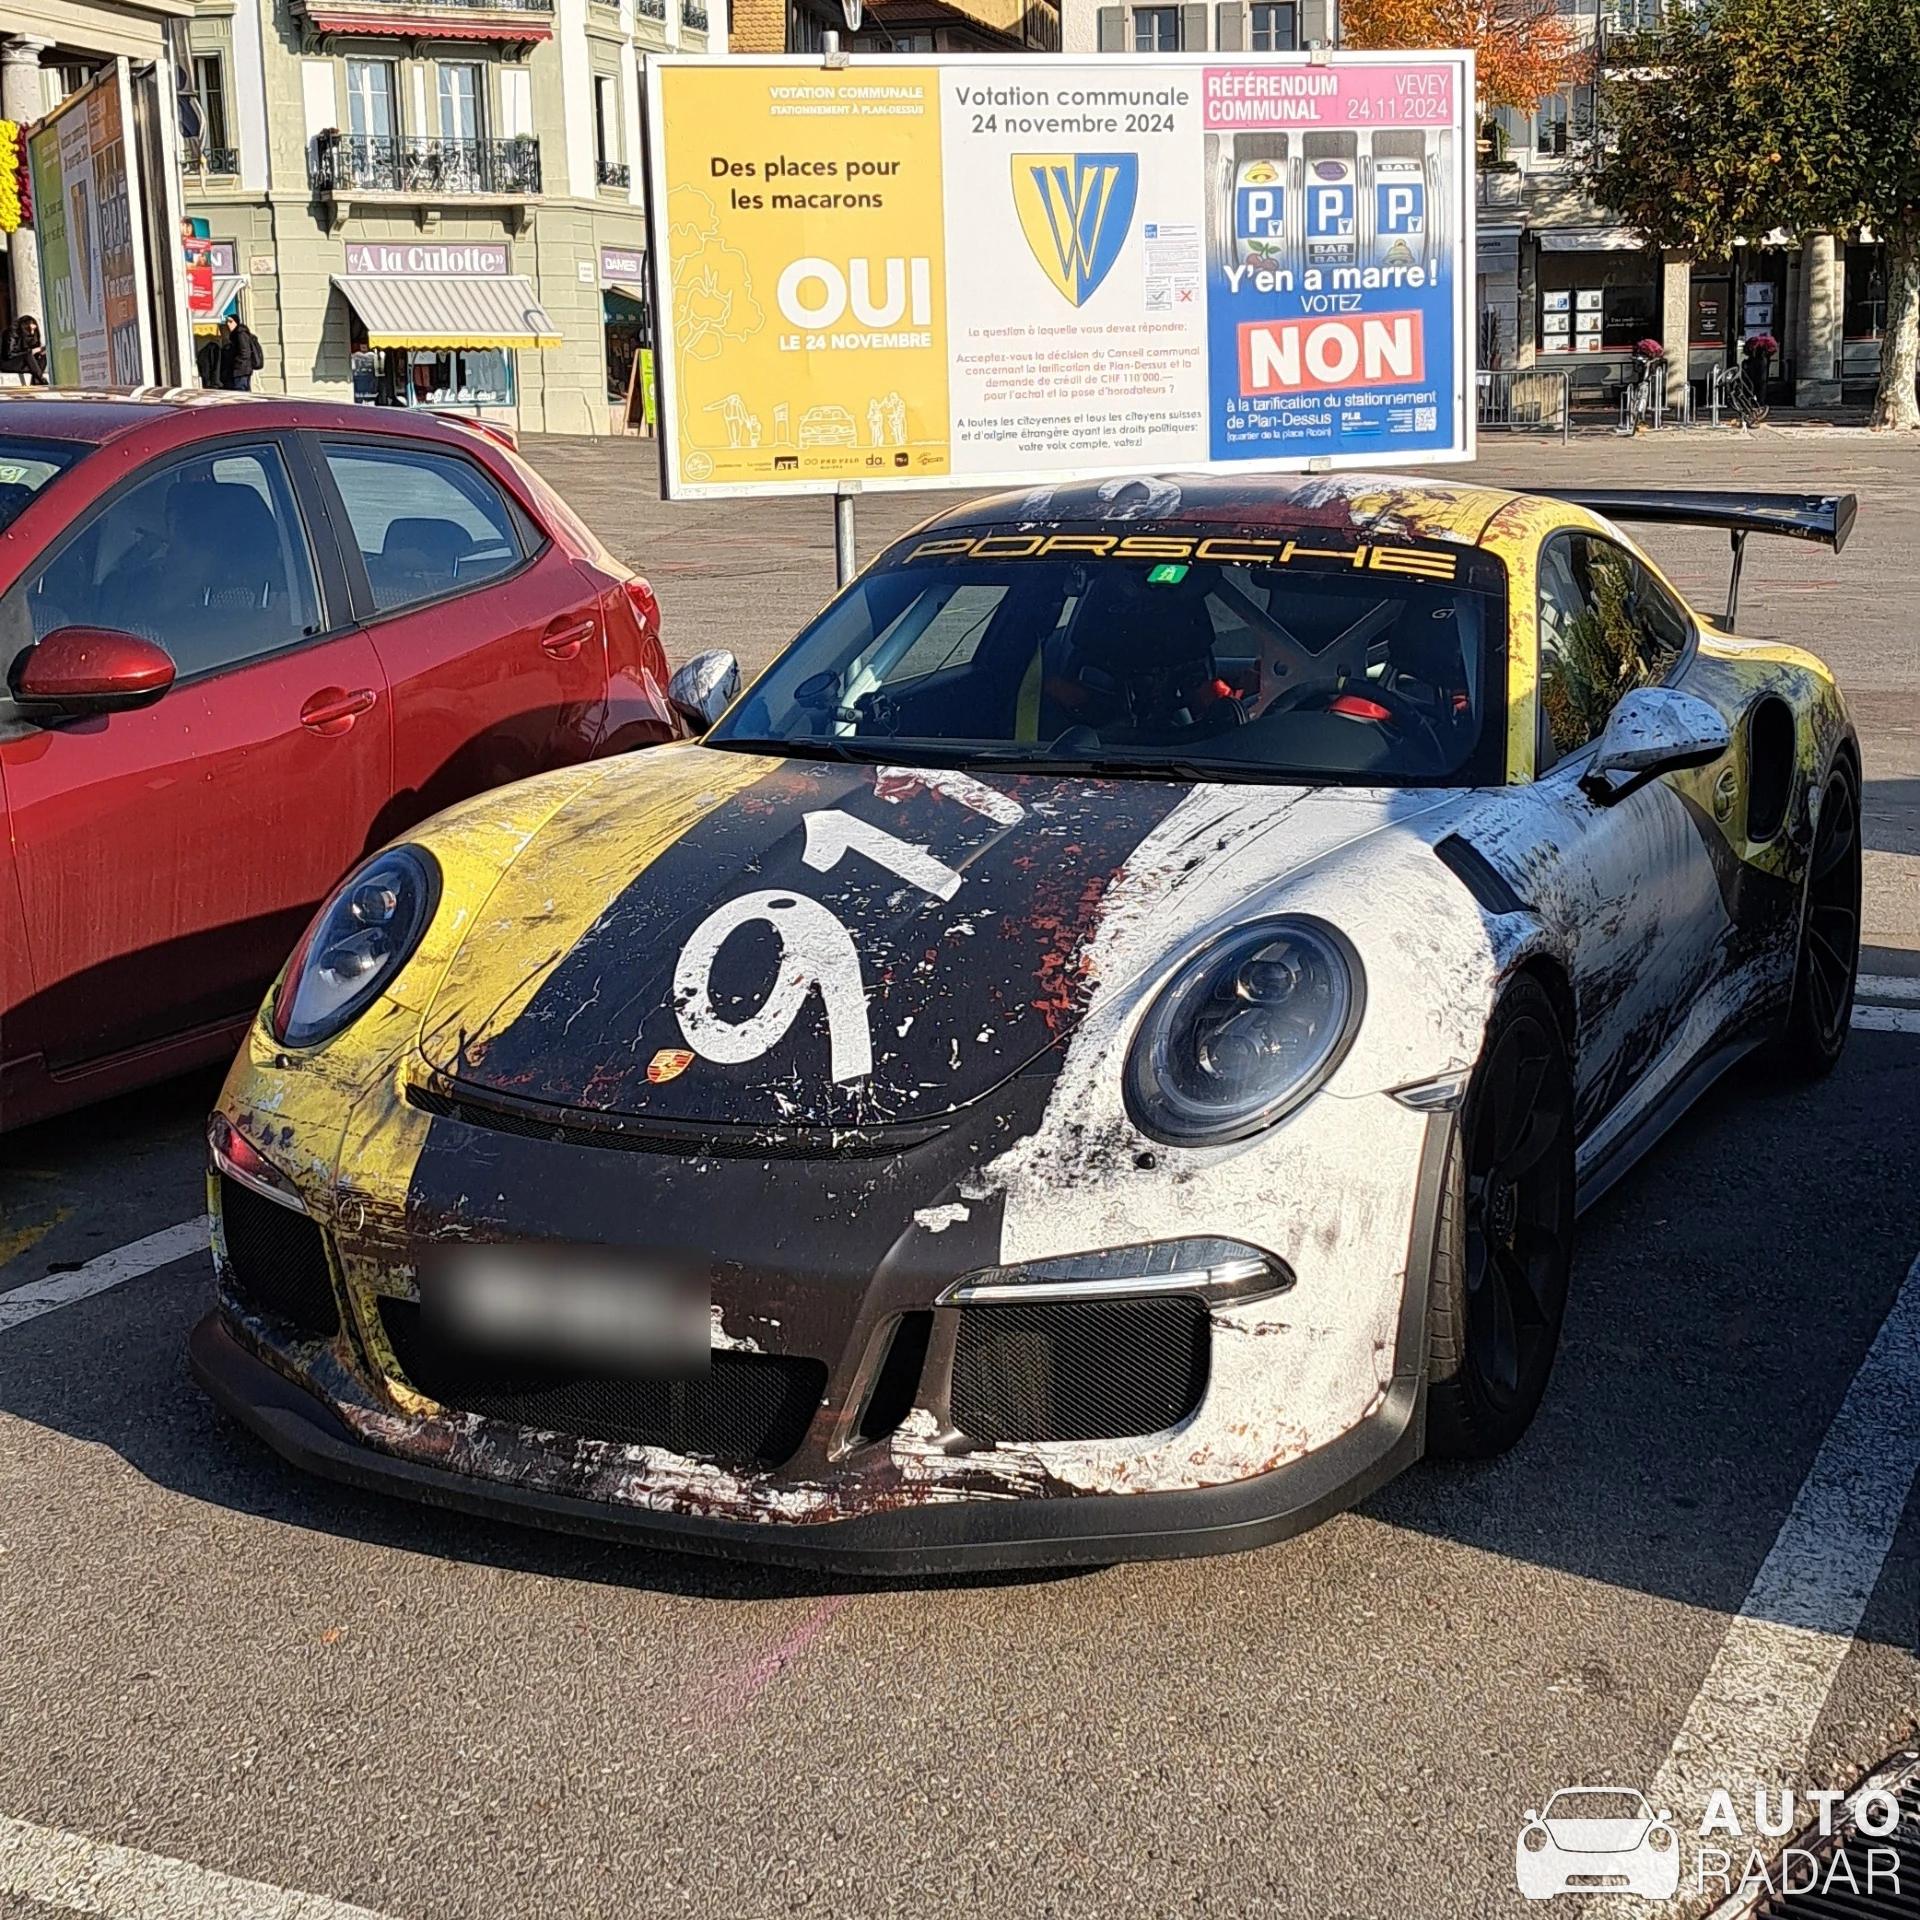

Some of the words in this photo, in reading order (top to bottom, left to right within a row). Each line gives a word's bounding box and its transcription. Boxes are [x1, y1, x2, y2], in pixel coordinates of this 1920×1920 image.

[769, 87, 835, 99] VOTATION
[838, 86, 924, 99] COMMUNALE
[1208, 72, 1337, 97] RÉFÉRENDUM
[1395, 74, 1448, 95] VEVEY
[955, 87, 1049, 106] Votation
[1057, 87, 1189, 106] communale
[770, 105, 850, 116] STATIONNEMENT
[851, 102, 860, 115] À
[862, 104, 924, 115] PLAN-DESSUS
[1208, 100, 1321, 121] COMMUNAL
[1348, 98, 1448, 119] 24.11.2024
[971, 113, 998, 133] 24
[1005, 113, 1118, 133] novembre
[1125, 113, 1175, 133] 2024
[711, 156, 756, 177] Des
[765, 155, 838, 182] places
[846, 160, 901, 182] pour
[1381, 163, 1416, 171] BAR
[731, 188, 764, 210] les
[771, 192, 884, 209] macarons
[1249, 191, 1273, 233] P
[1318, 189, 1343, 231] P
[1388, 188, 1413, 229] P
[1314, 243, 1348, 254] BAR
[380, 247, 403, 272] la
[604, 257, 638, 272] DAMES
[1314, 254, 1348, 264] BAR
[1223, 264, 1294, 293] Y'en
[1304, 269, 1322, 290] a
[777, 257, 932, 329] OUI
[1301, 294, 1362, 312] VOTEZ
[968, 327, 980, 337] La
[983, 327, 1025, 338] question
[1037, 325, 1078, 337] laquelle
[1080, 325, 1103, 334] vous
[1106, 324, 1137, 334] devez
[780, 334, 802, 351] LE
[805, 334, 826, 350] 24
[831, 332, 932, 350] NOVEMBRE
[956, 352, 1033, 364] Acceptez-vous
[1035, 351, 1045, 361] la
[1048, 349, 1089, 360] décision
[1092, 348, 1105, 359] du
[1107, 347, 1144, 358] Conseil
[1146, 346, 1200, 357] communal
[1250, 317, 1413, 388] NON
[965, 365, 1024, 376] concernant
[1026, 363, 1036, 374] la
[1038, 362, 1091, 374] tarification
[1093, 361, 1107, 371] de
[1109, 359, 1168, 372] Plan-Dessus
[1170, 359, 1180, 369] et
[1182, 359, 1192, 369] la
[985, 377, 1034, 388] demande
[1037, 376, 1051, 386] de
[1053, 374, 1082, 385] crédit
[1085, 374, 1098, 384] de
[1100, 373, 1121, 384] CHF
[983, 391, 1007, 402] pour
[1009, 388, 1044, 400] l'achat
[1047, 387, 1057, 398] et
[1059, 387, 1069, 397] la
[1071, 387, 1095, 398] pose
[1097, 385, 1166, 397] d'horodateurs
[1168, 384, 1175, 395] ?
[1226, 398, 1236, 412] à
[1238, 398, 1250, 411] la
[1253, 395, 1320, 410] tarification
[1324, 394, 1341, 408] du
[1345, 391, 1437, 407] stationnement
[957, 419, 965, 428] A
[967, 417, 998, 428] toutes
[1001, 417, 1014, 427] les
[1017, 415, 1071, 427] citoyennes
[1074, 414, 1084, 424] et
[1086, 413, 1106, 424] tous
[1109, 412, 1122, 422] les
[1125, 411, 1166, 422] citoyens
[1169, 409, 1202, 420] suisses
[1226, 415, 1244, 429] de
[1247, 412, 1332, 428] Plan-Dessus
[1341, 412, 1361, 420] PLR
[961, 431, 971, 441] et
[1020, 427, 1069, 440] étrangère
[1072, 427, 1100, 438] ayant
[1103, 425, 1116, 435] les
[1119, 424, 1145, 434] droits
[1260, 430, 1271, 440] de
[1272, 429, 1281, 439] la
[1282, 429, 1304, 440] place
[1018, 441, 1043, 452] votre
[1046, 440, 1067, 450] voix
[903, 535, 1456, 580] PORSCHE
